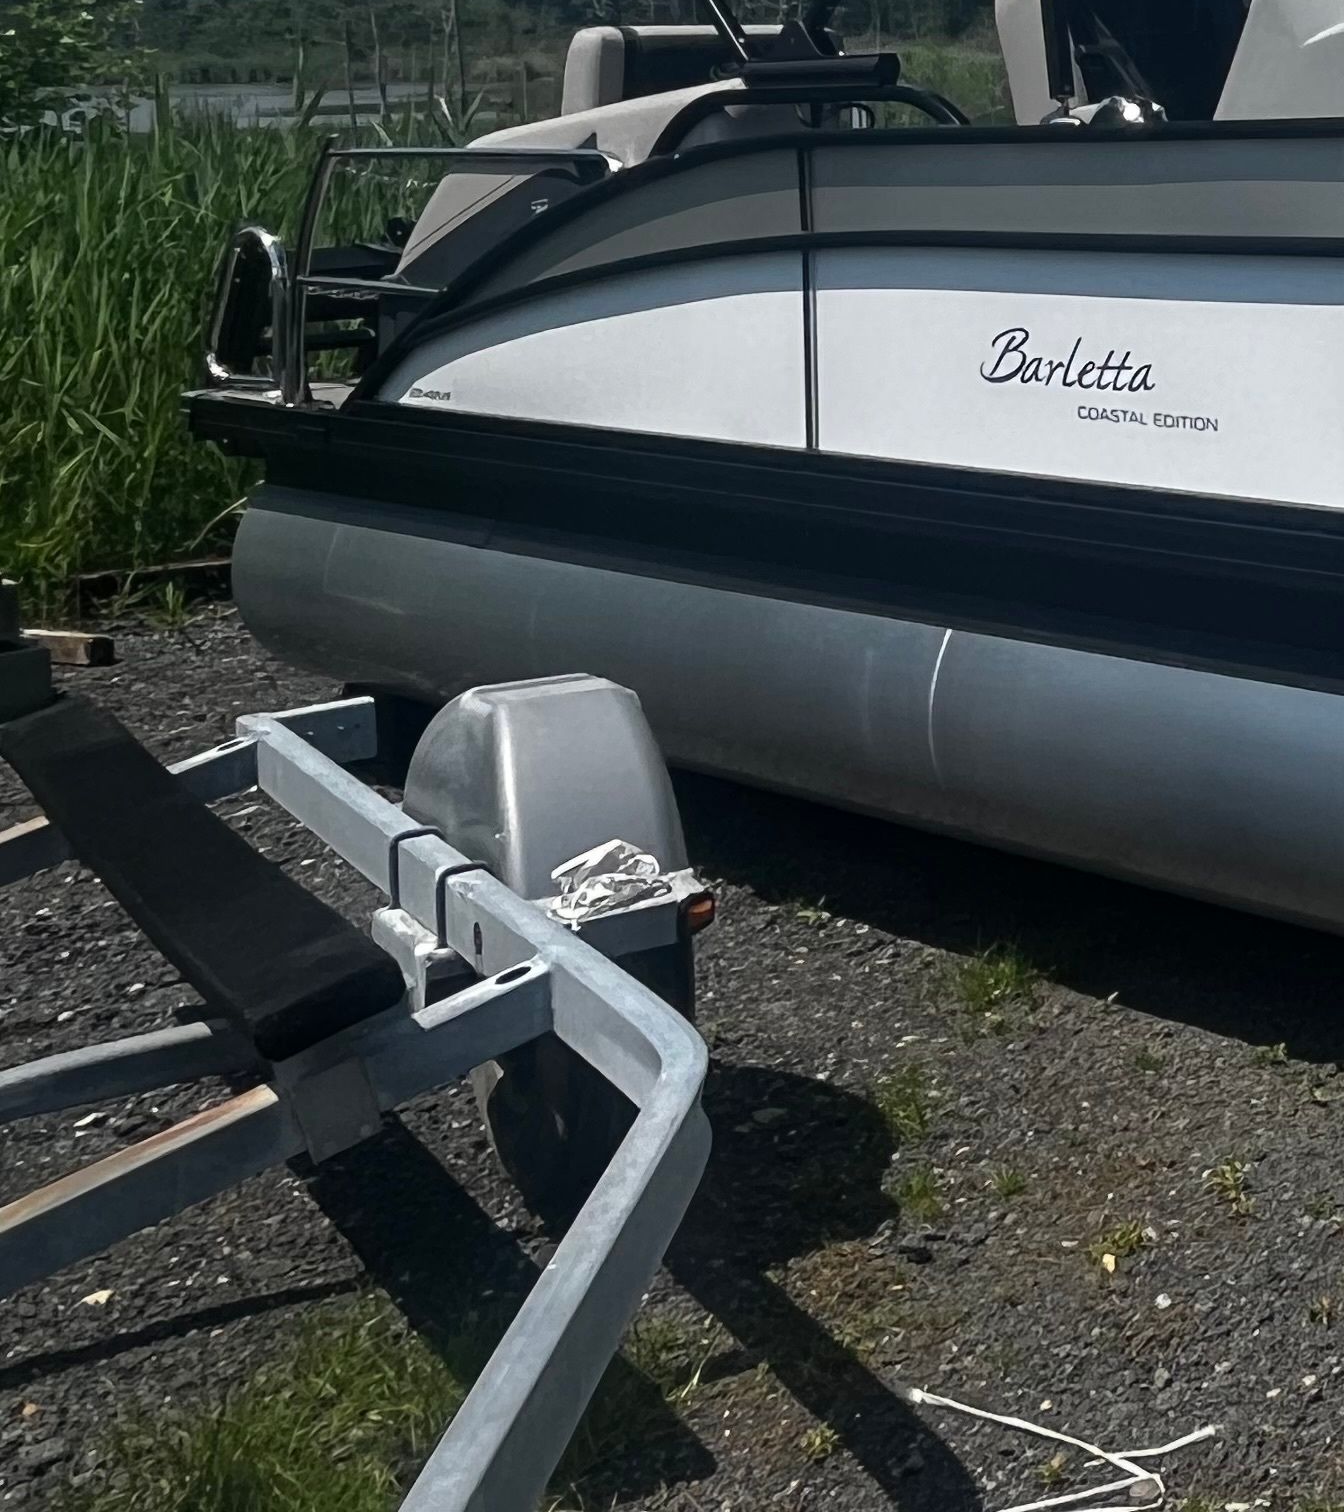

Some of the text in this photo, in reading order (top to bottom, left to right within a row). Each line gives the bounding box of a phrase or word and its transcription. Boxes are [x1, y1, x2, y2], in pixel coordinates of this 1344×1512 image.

[980, 327, 1156, 393] Barletta
[1077, 405, 1219, 432] COASTAL EDITION
